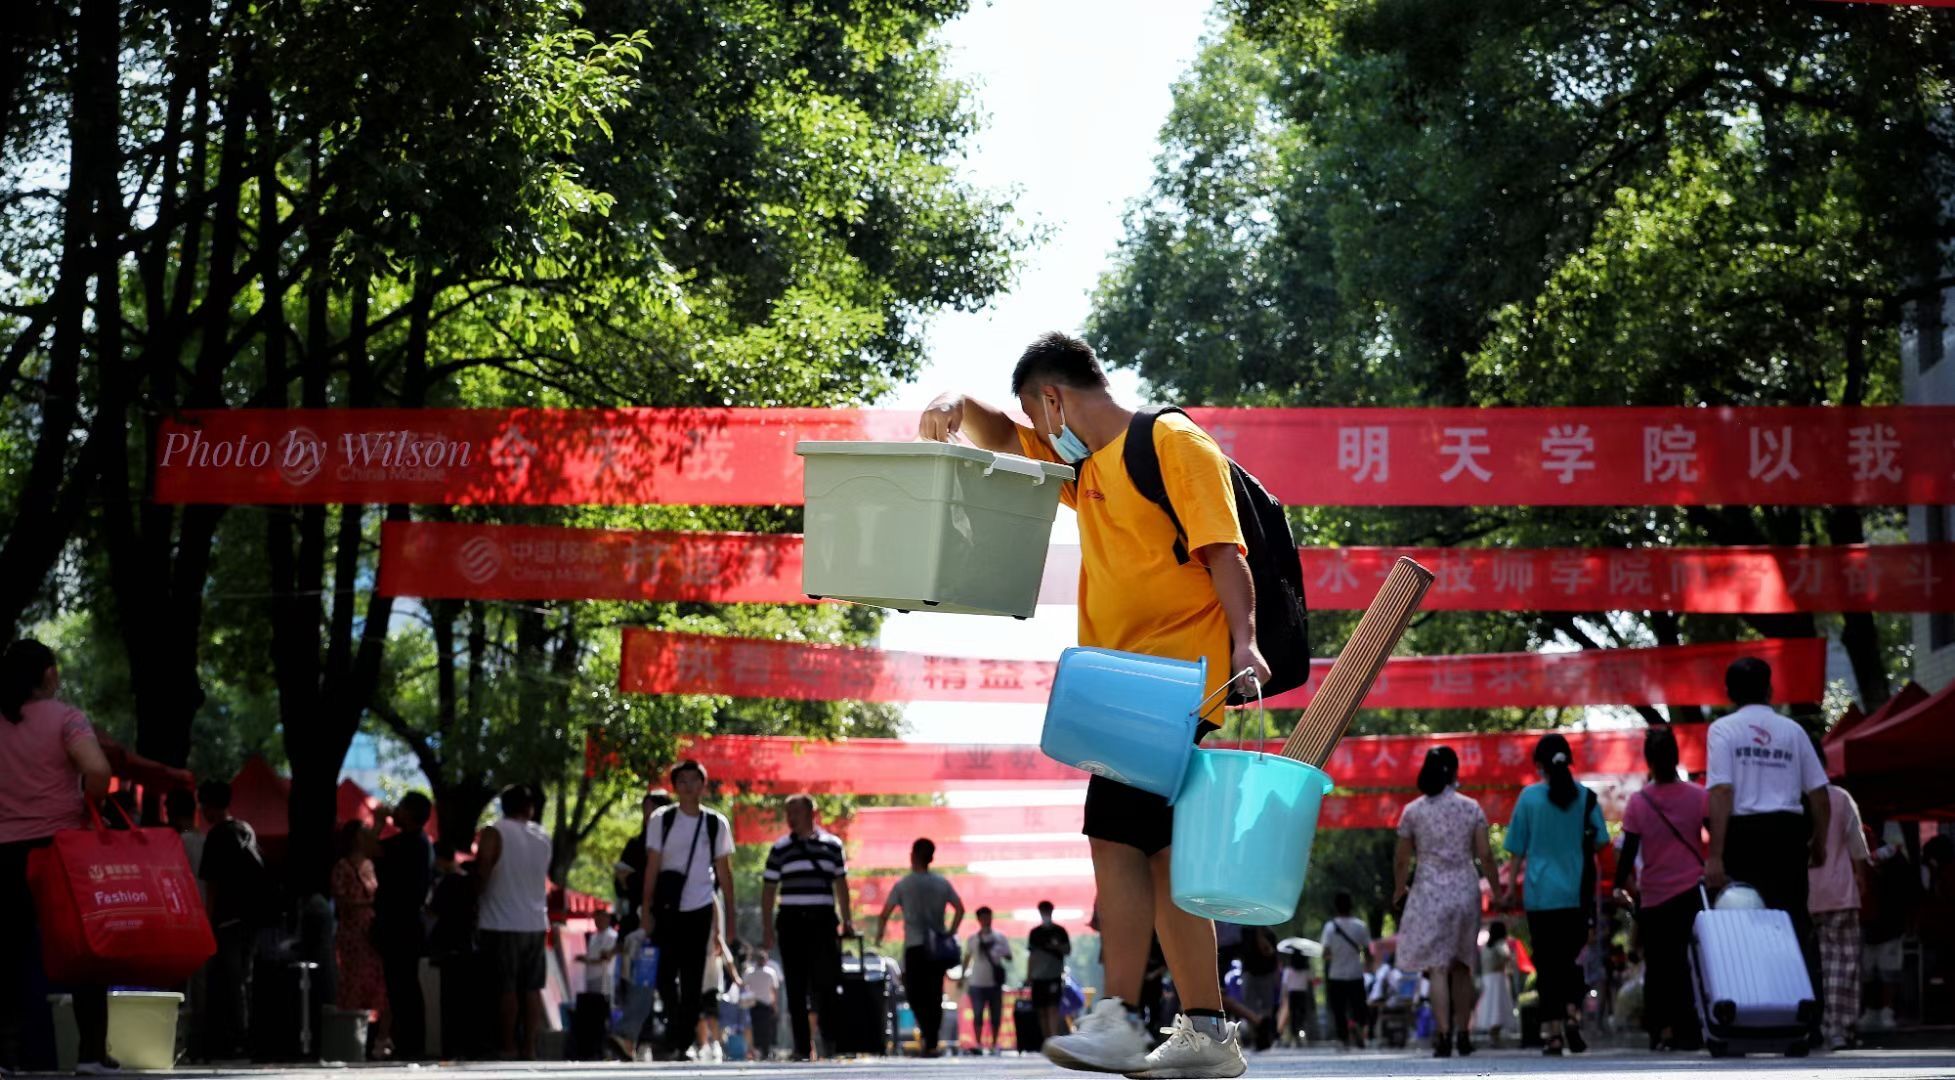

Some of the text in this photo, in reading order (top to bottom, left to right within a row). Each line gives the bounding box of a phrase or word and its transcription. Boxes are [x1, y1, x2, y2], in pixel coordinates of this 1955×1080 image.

[1336, 424, 1903, 485] 明天学院以我
[1315, 554, 1942, 598] 水技师学院而努力奋斗
[94, 890, 148, 905] Fashion
